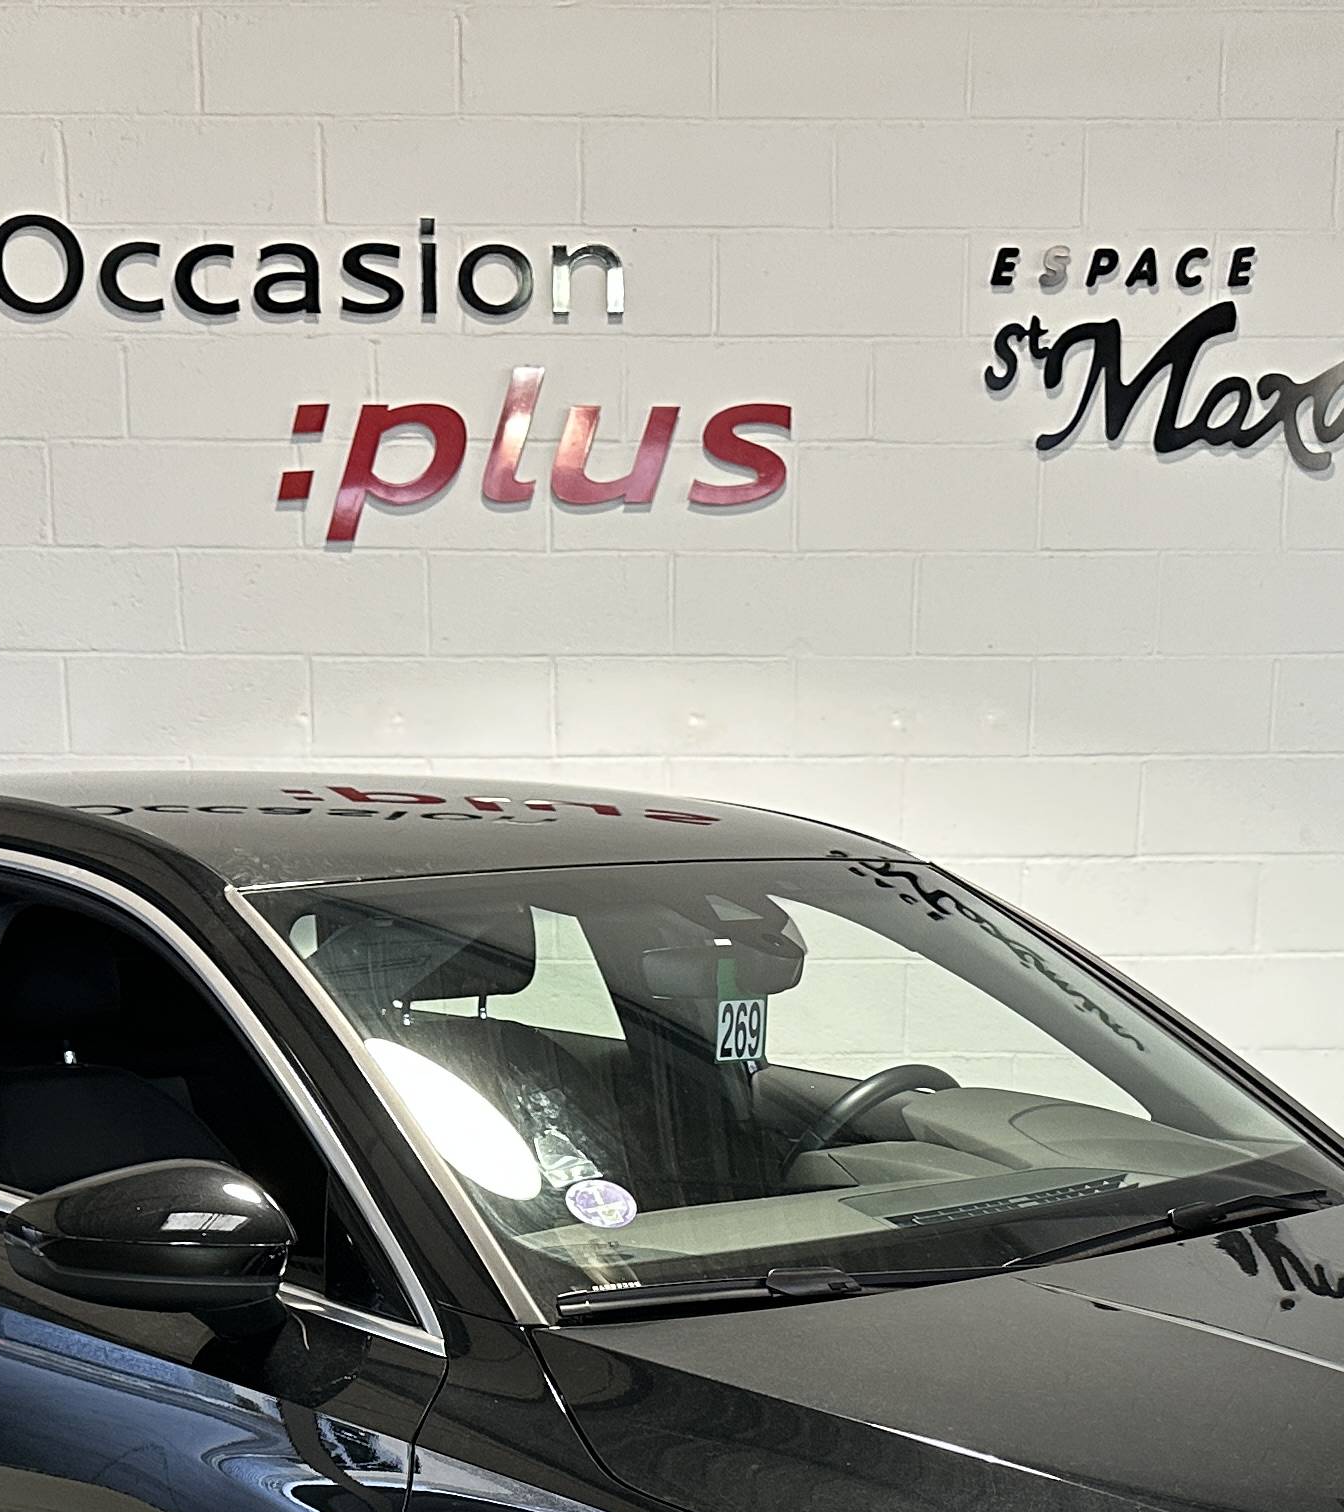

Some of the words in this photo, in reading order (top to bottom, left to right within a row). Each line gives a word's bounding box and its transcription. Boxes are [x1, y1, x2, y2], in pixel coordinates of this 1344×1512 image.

[990, 246, 1256, 287] ESPACE
[985, 315, 1051, 392] St
[719, 1001, 762, 1059] 269
